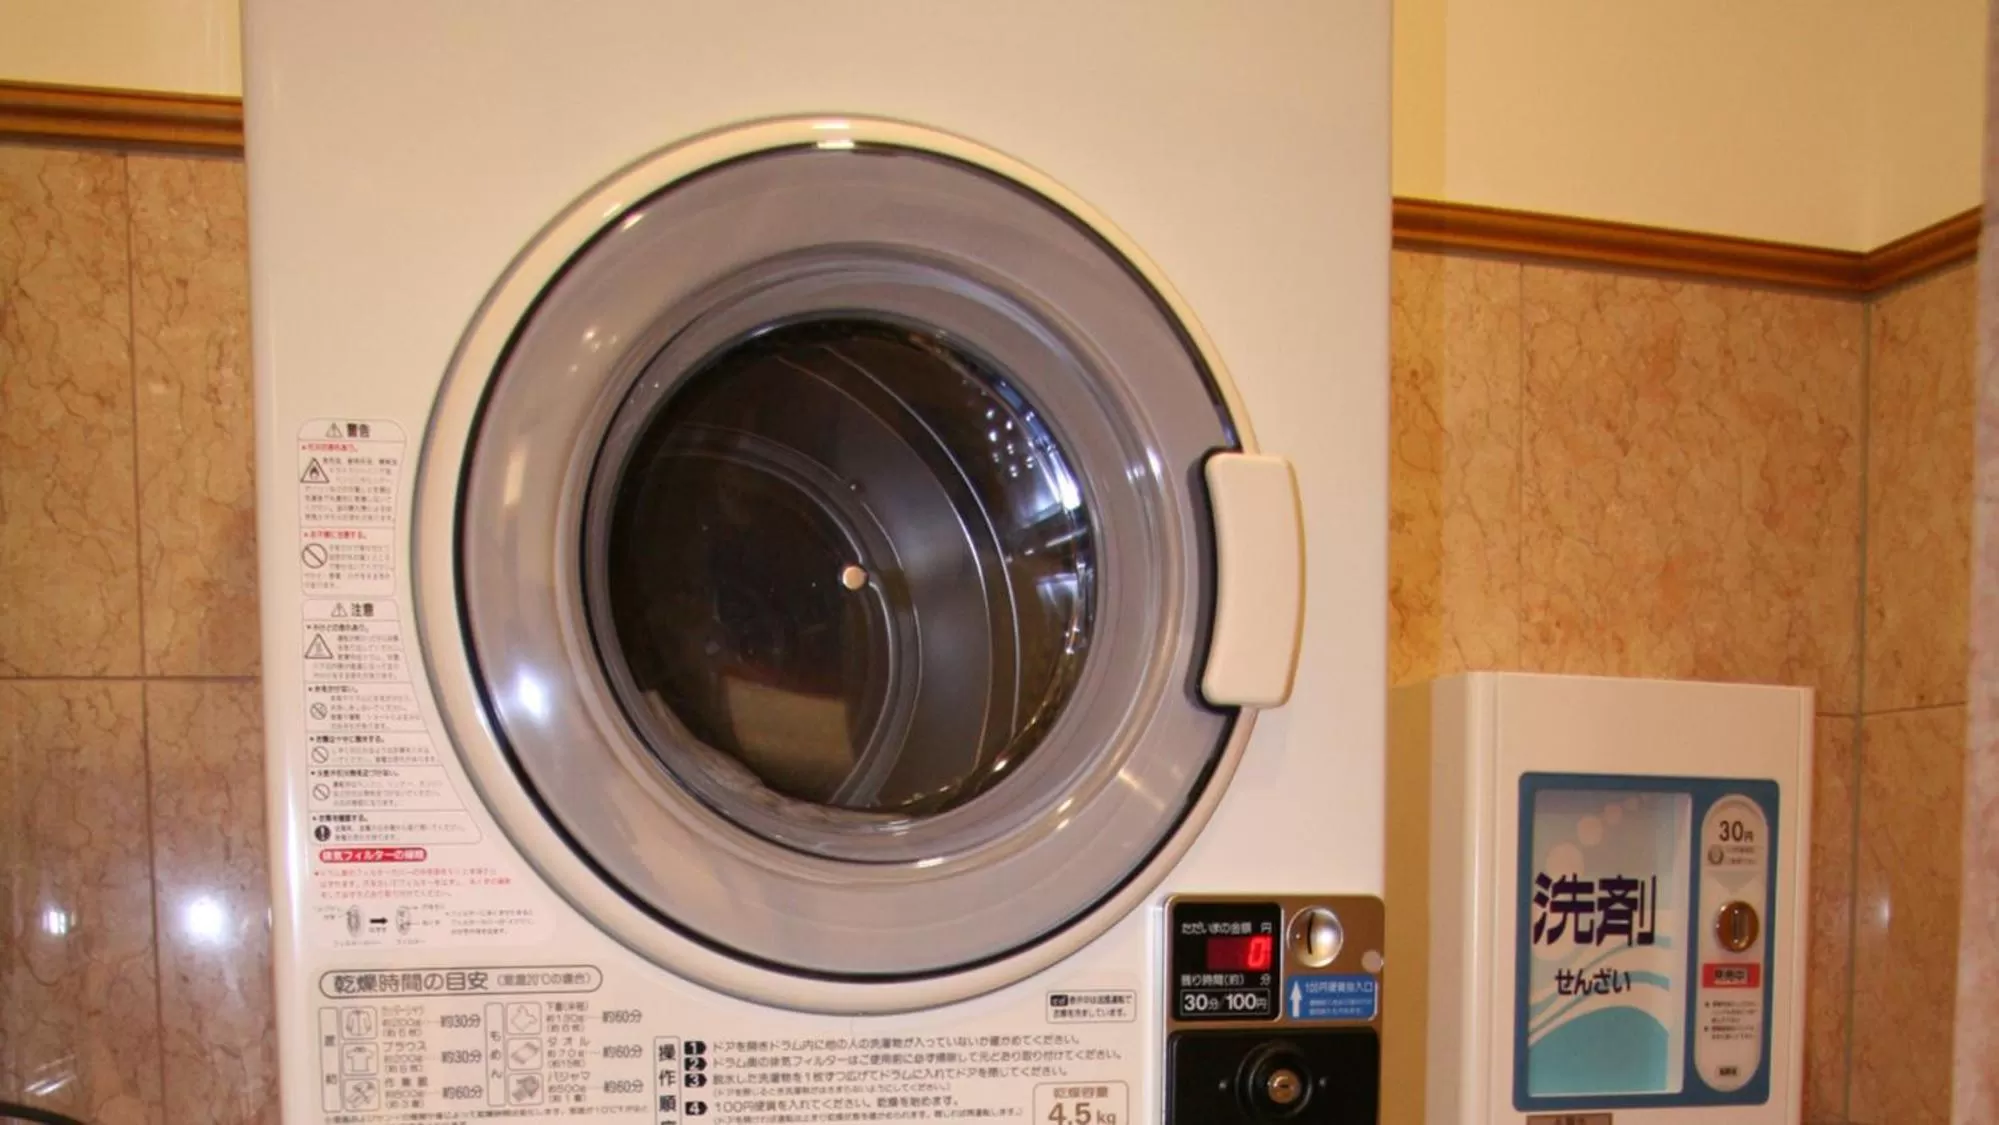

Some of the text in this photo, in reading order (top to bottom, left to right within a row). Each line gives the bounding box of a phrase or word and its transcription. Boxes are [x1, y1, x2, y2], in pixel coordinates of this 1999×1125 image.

[351, 602, 374, 617] 注意
[1718, 820, 1753, 842] 30円
[1532, 872, 1656, 947] 洗剤
[1181, 922, 1272, 935] ただいまの金額 円
[1248, 935, 1272, 969] 0
[334, 971, 489, 993] 乾燥時間の目安
[1260, 974, 1272, 986] 分
[1555, 968, 1631, 996] せんざい
[440, 1014, 481, 1028] 約30分
[602, 1009, 643, 1023] 約60分
[383, 1041, 427, 1052] ブラウス
[602, 1044, 643, 1059] 約60分
[441, 1050, 482, 1064] 約30分
[442, 1086, 484, 1100] 約60分
[603, 1080, 644, 1094] 約60分
[1053, 1086, 1109, 1099] 乾燥容量
[1047, 1102, 1117, 1125] 4.5 kg
